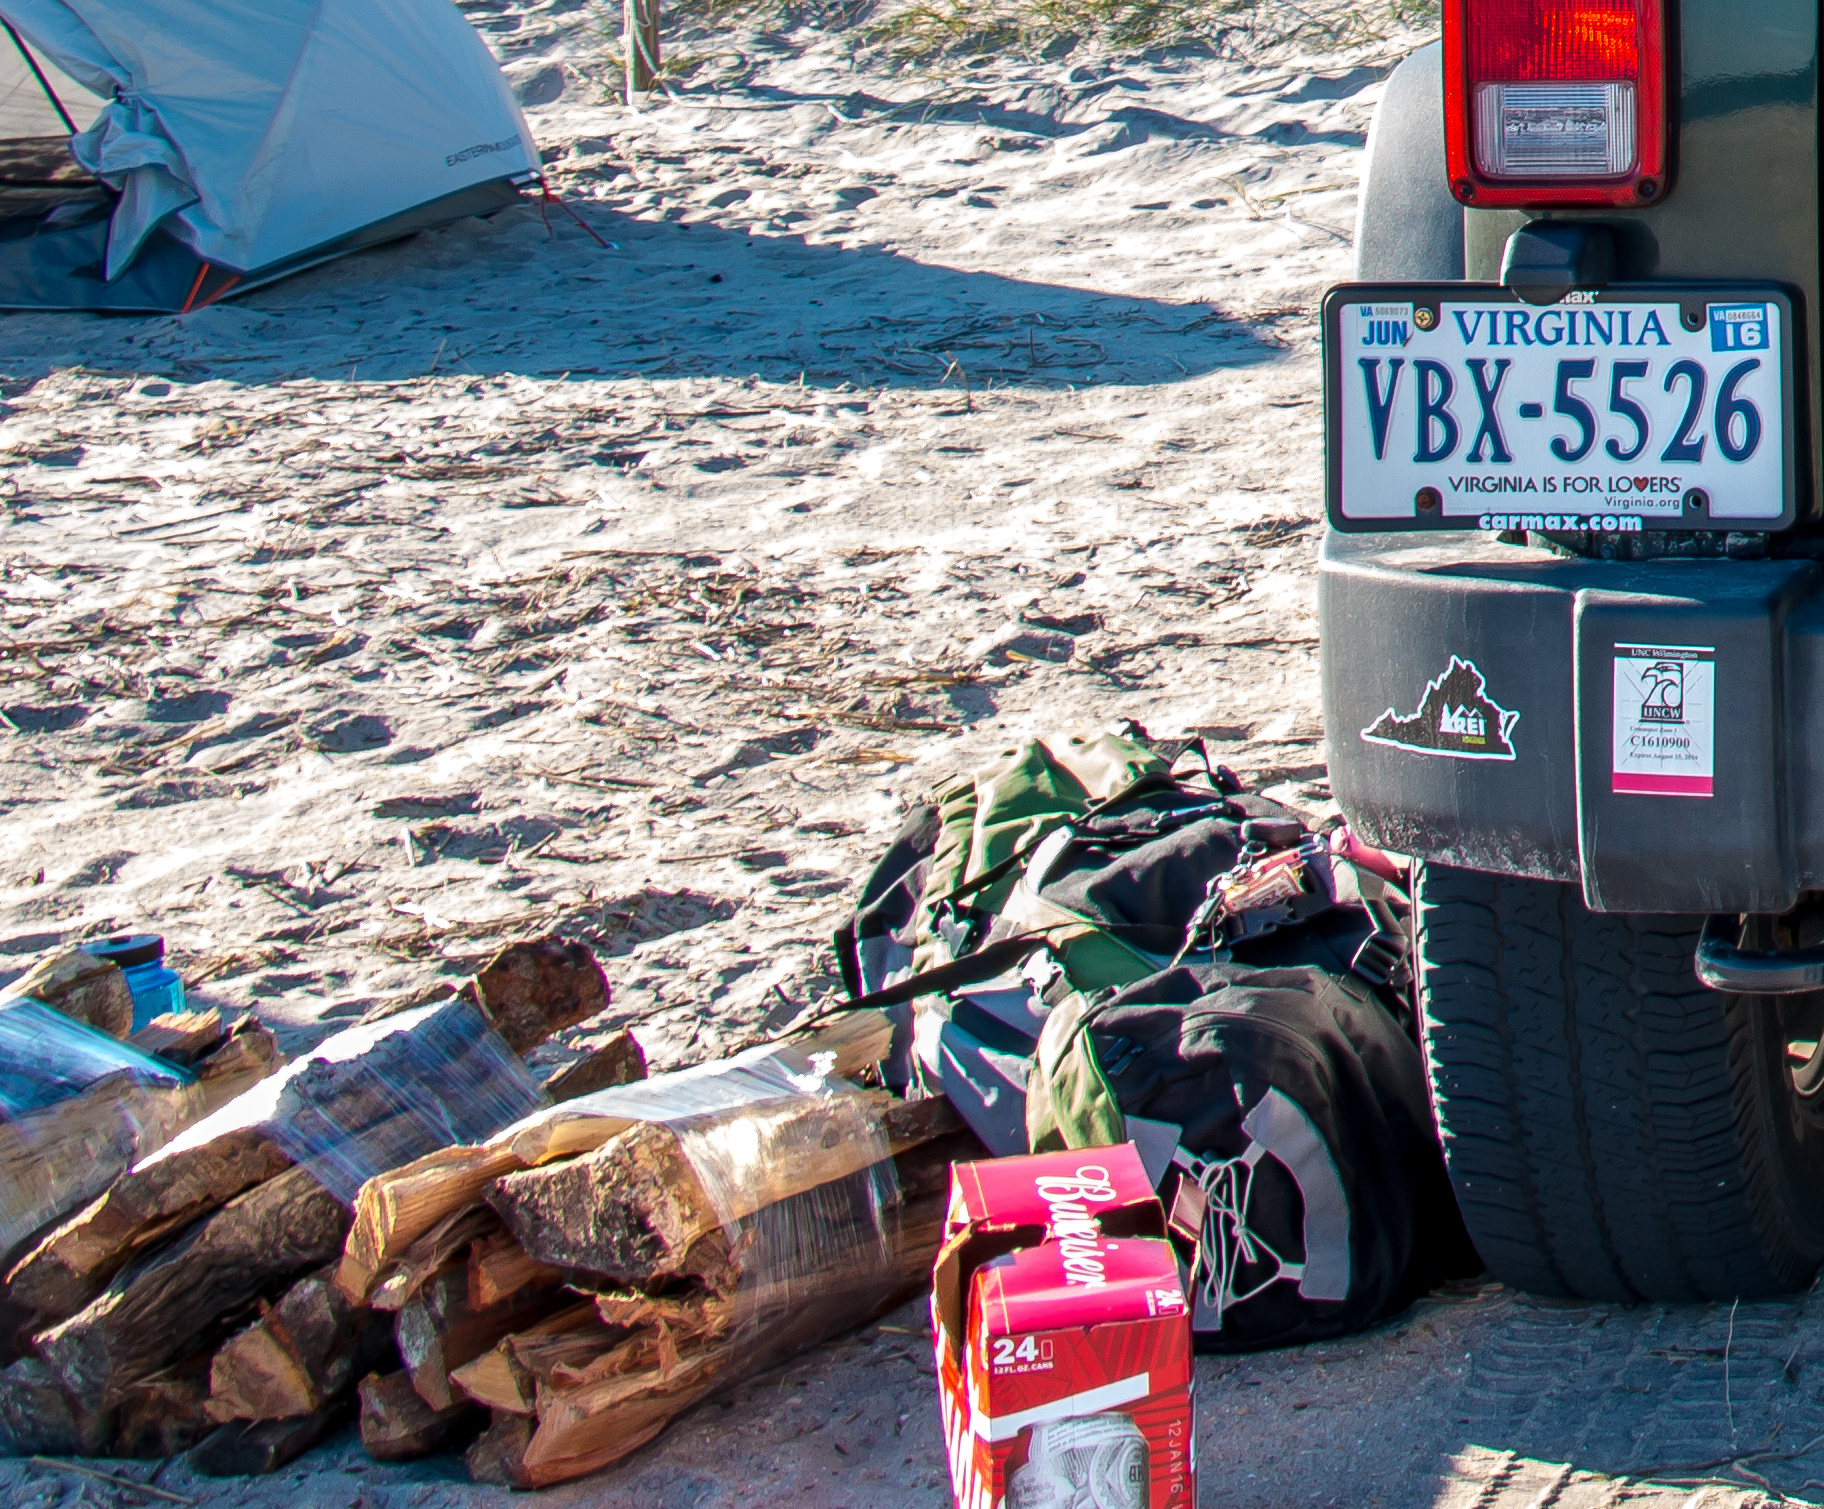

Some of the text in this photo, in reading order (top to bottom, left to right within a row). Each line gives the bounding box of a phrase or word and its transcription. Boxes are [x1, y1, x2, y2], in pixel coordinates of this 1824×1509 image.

[1360, 306, 1373, 317] VA
[1713, 310, 1725, 321] VA
[1361, 320, 1408, 346] JUN
[1452, 309, 1672, 347] VIRGINIA
[1726, 322, 1762, 347] 16
[1357, 357, 1763, 464] VBX-5526
[1448, 476, 1539, 493] VIRGINIA
[1543, 476, 1557, 493] IS
[1563, 476, 1603, 493] FOR
[1604, 495, 1681, 510] Virginia.org
[1478, 513, 1643, 532] carmax.com
[1631, 648, 1650, 657] UNC
[1643, 706, 1682, 719] UNCW
[1454, 717, 1486, 736] REI
[1154, 1289, 1184, 1307] 24
[992, 1335, 1039, 1365] 24
[1031, 1361, 1054, 1371] CANS
